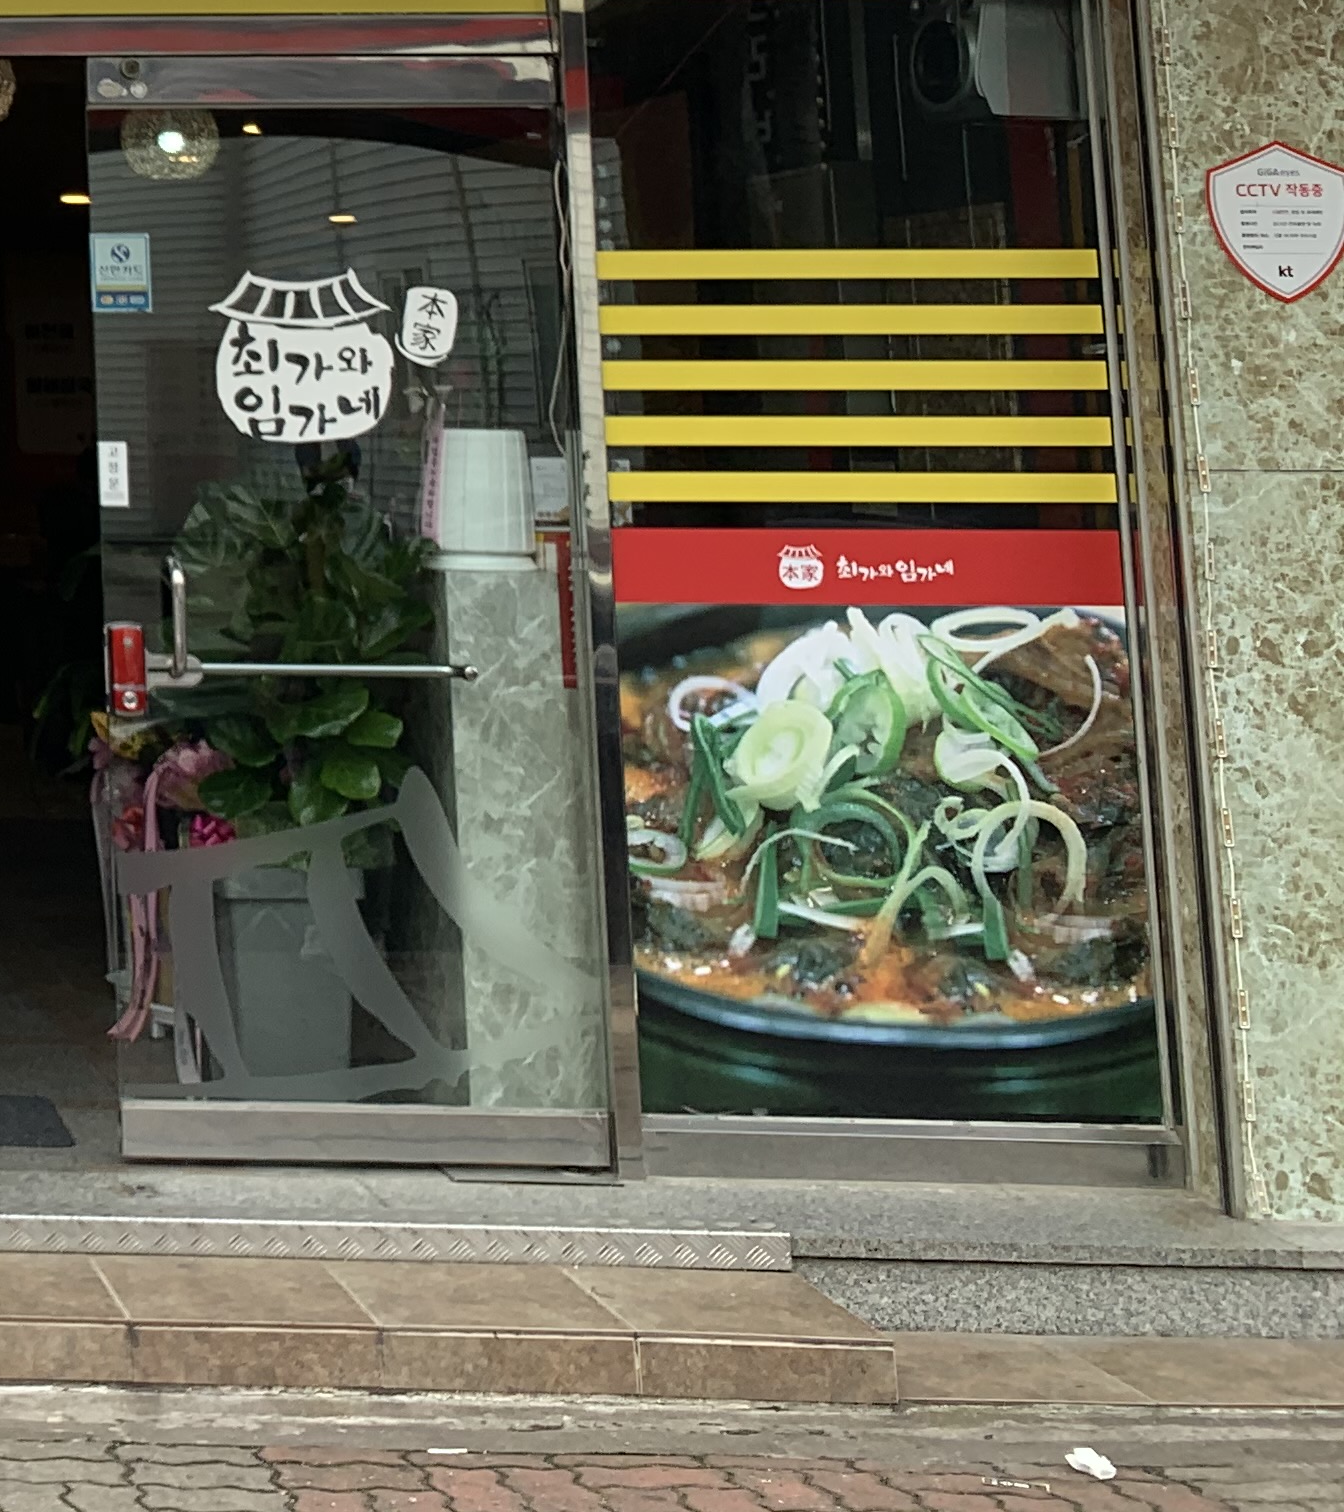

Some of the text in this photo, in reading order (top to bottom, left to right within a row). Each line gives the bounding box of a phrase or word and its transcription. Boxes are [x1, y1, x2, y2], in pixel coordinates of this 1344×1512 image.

[1235, 182, 1324, 198] CCTV 작동중
[1278, 265, 1294, 278] kt
[231, 322, 373, 384] 최가와
[235, 386, 381, 439] 임가네
